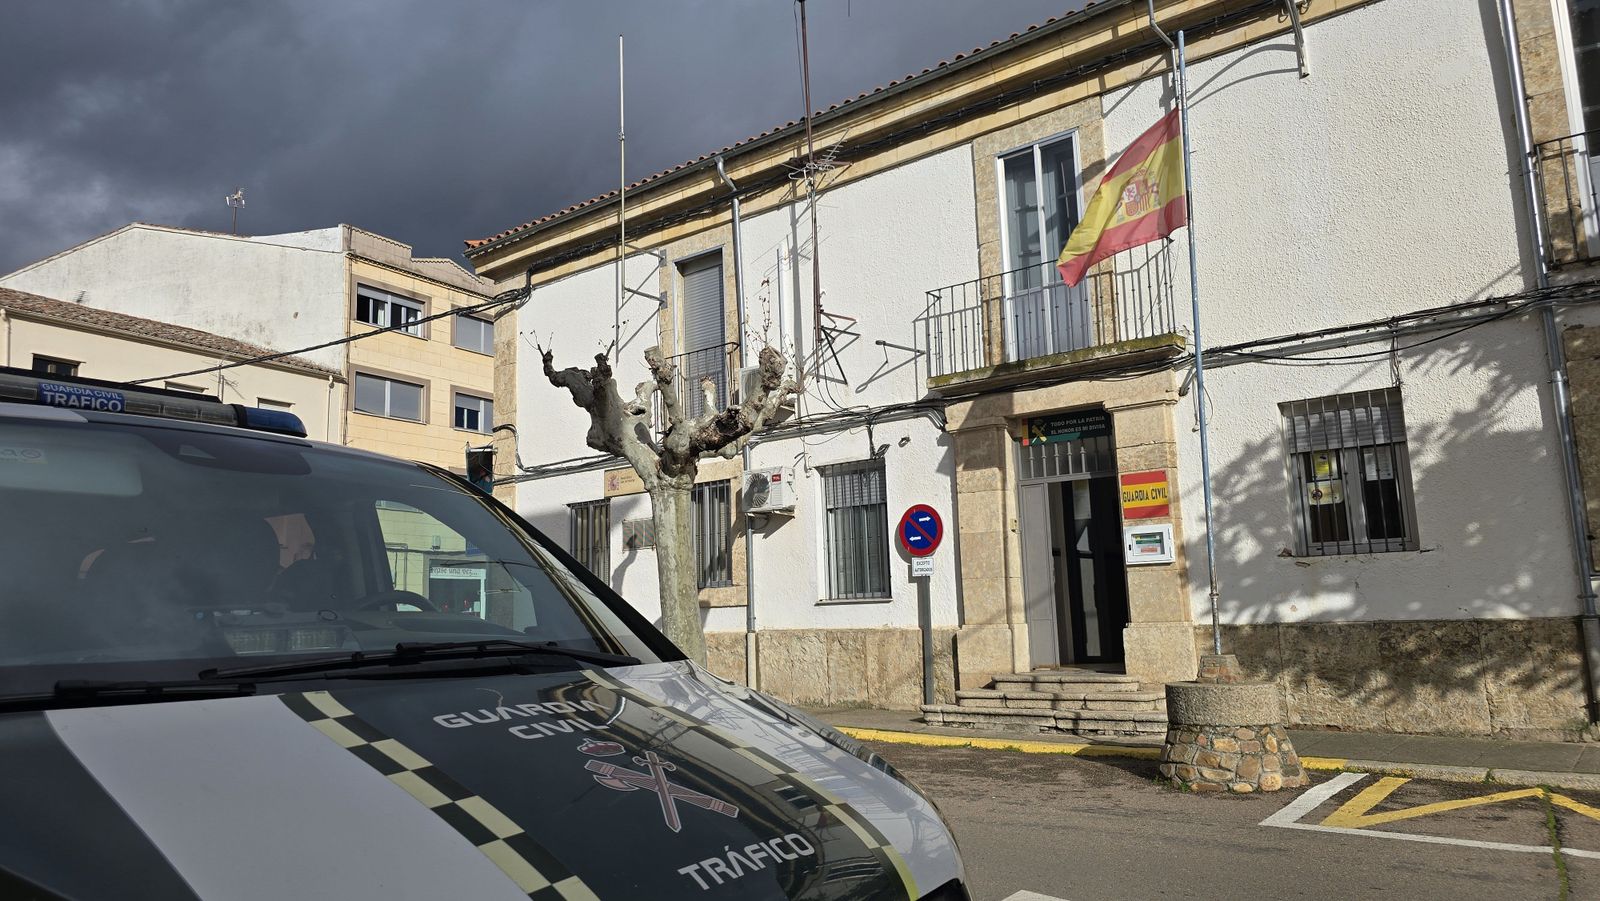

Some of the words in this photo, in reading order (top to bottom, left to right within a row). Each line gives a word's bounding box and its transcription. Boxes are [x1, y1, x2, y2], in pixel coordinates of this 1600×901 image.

[42, 383, 93, 397] GUARDIA
[94, 389, 123, 400] CIVIL
[43, 391, 122, 412] TRAFICO
[1122, 489, 1150, 503] GUARDIA
[1150, 487, 1168, 500] CIVIL
[433, 700, 610, 728] GUARDIA
[508, 718, 610, 740] CIVIL
[677, 833, 815, 891] TRÁFICO
